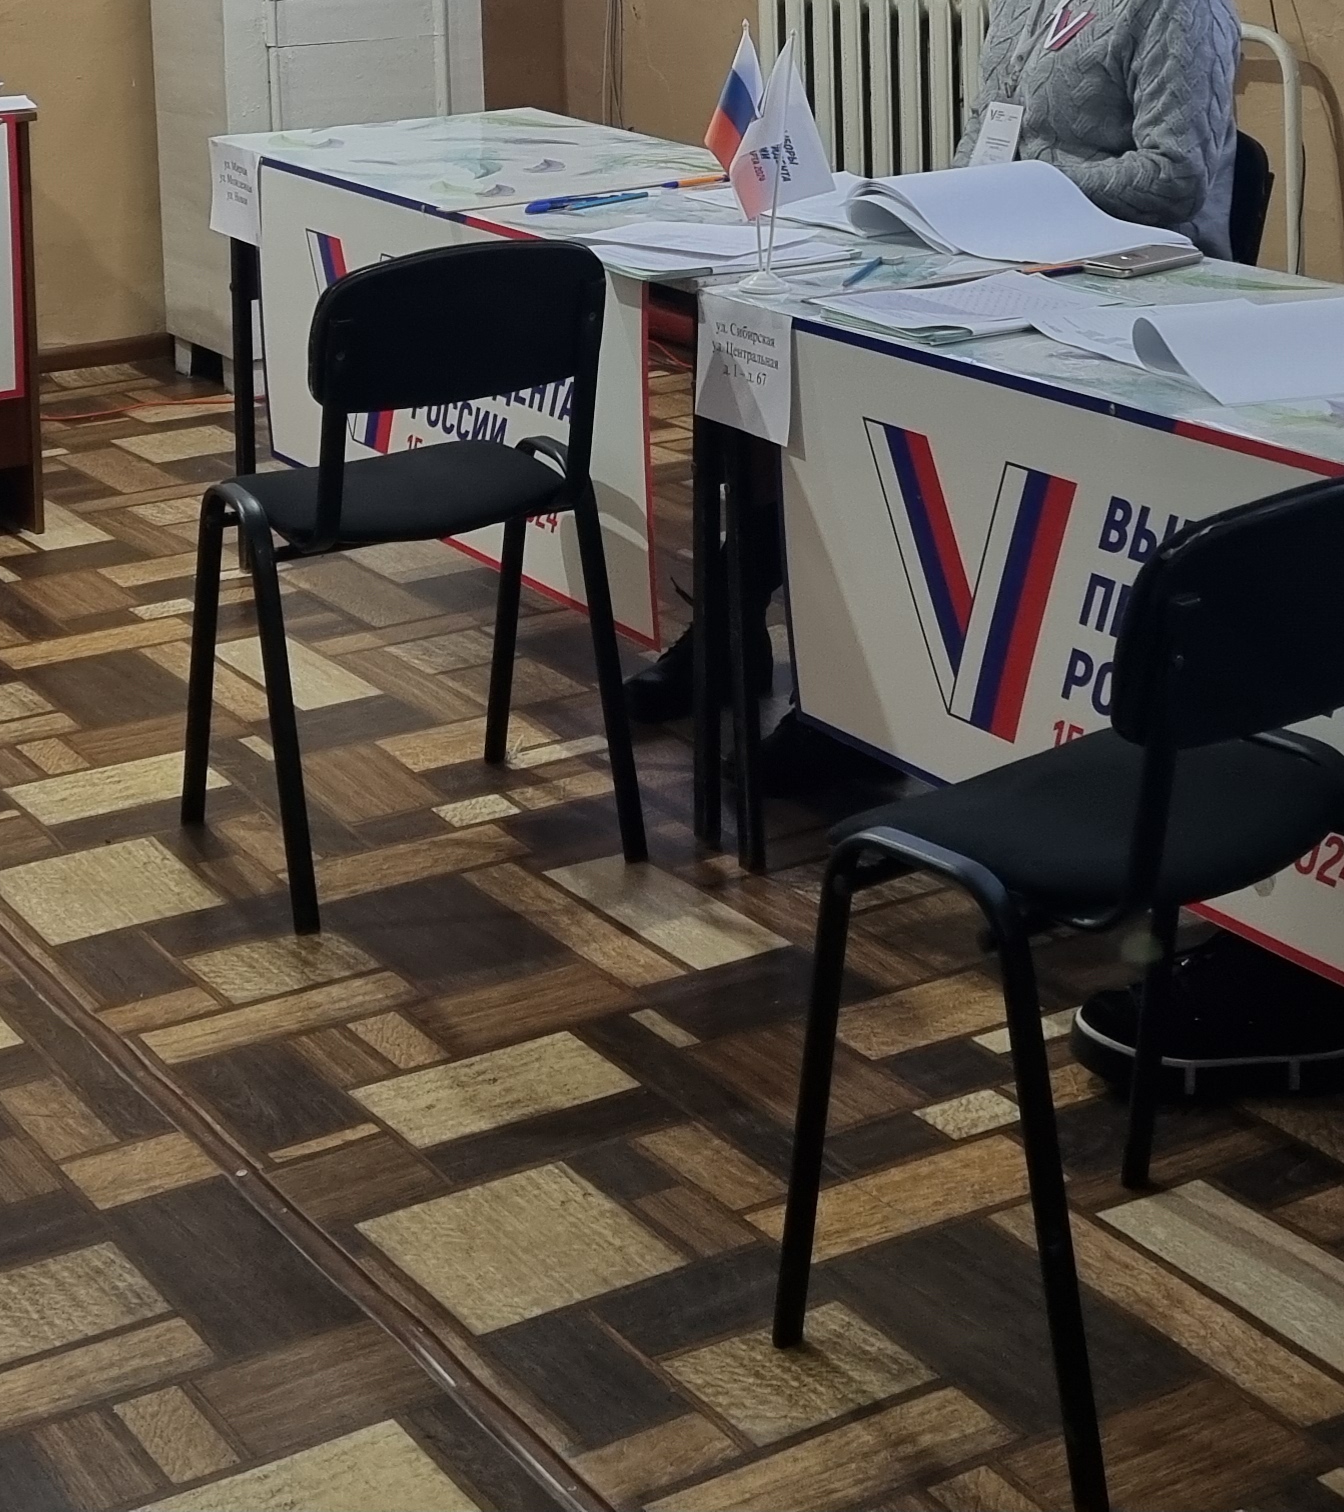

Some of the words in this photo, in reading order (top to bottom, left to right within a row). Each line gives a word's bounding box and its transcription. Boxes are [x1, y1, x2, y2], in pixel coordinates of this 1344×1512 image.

[730, 322, 775, 348] Сибирская
[726, 341, 779, 370] Центральная
[756, 371, 767, 386] 67
